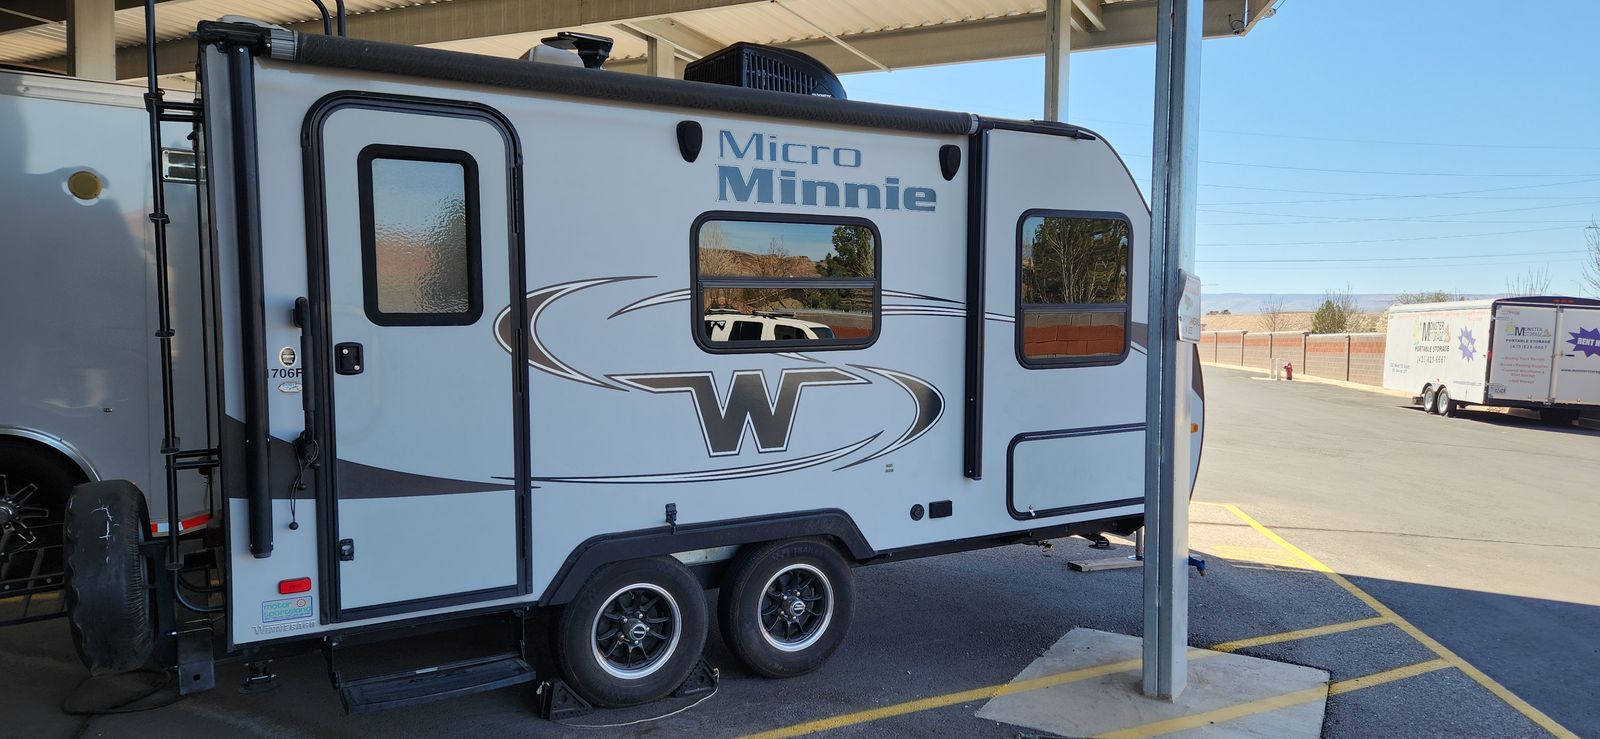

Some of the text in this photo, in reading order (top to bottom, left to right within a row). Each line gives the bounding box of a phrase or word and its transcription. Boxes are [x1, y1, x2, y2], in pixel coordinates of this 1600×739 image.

[719, 130, 862, 168] Micro
[716, 164, 937, 212] Minnie
[1415, 345, 1450, 353] PORTABLE STORAGE
[1577, 337, 1595, 347] RENT
[604, 367, 872, 457] W
